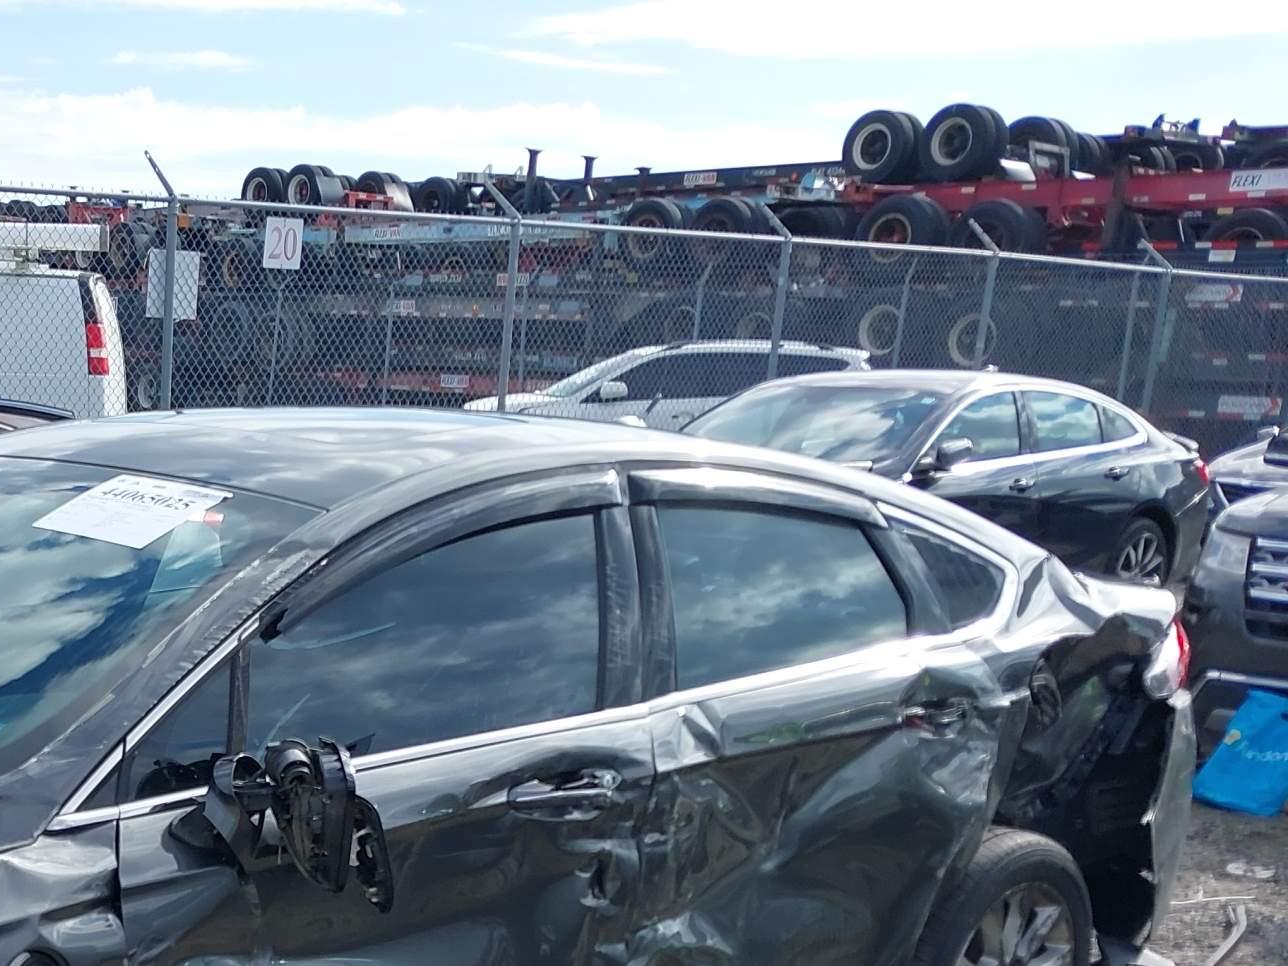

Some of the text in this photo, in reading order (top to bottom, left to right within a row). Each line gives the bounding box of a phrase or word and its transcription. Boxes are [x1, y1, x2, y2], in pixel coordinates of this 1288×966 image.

[1231, 174, 1262, 187] FLEXI
[269, 227, 297, 260] 20
[102, 488, 197, 510] 44065025
